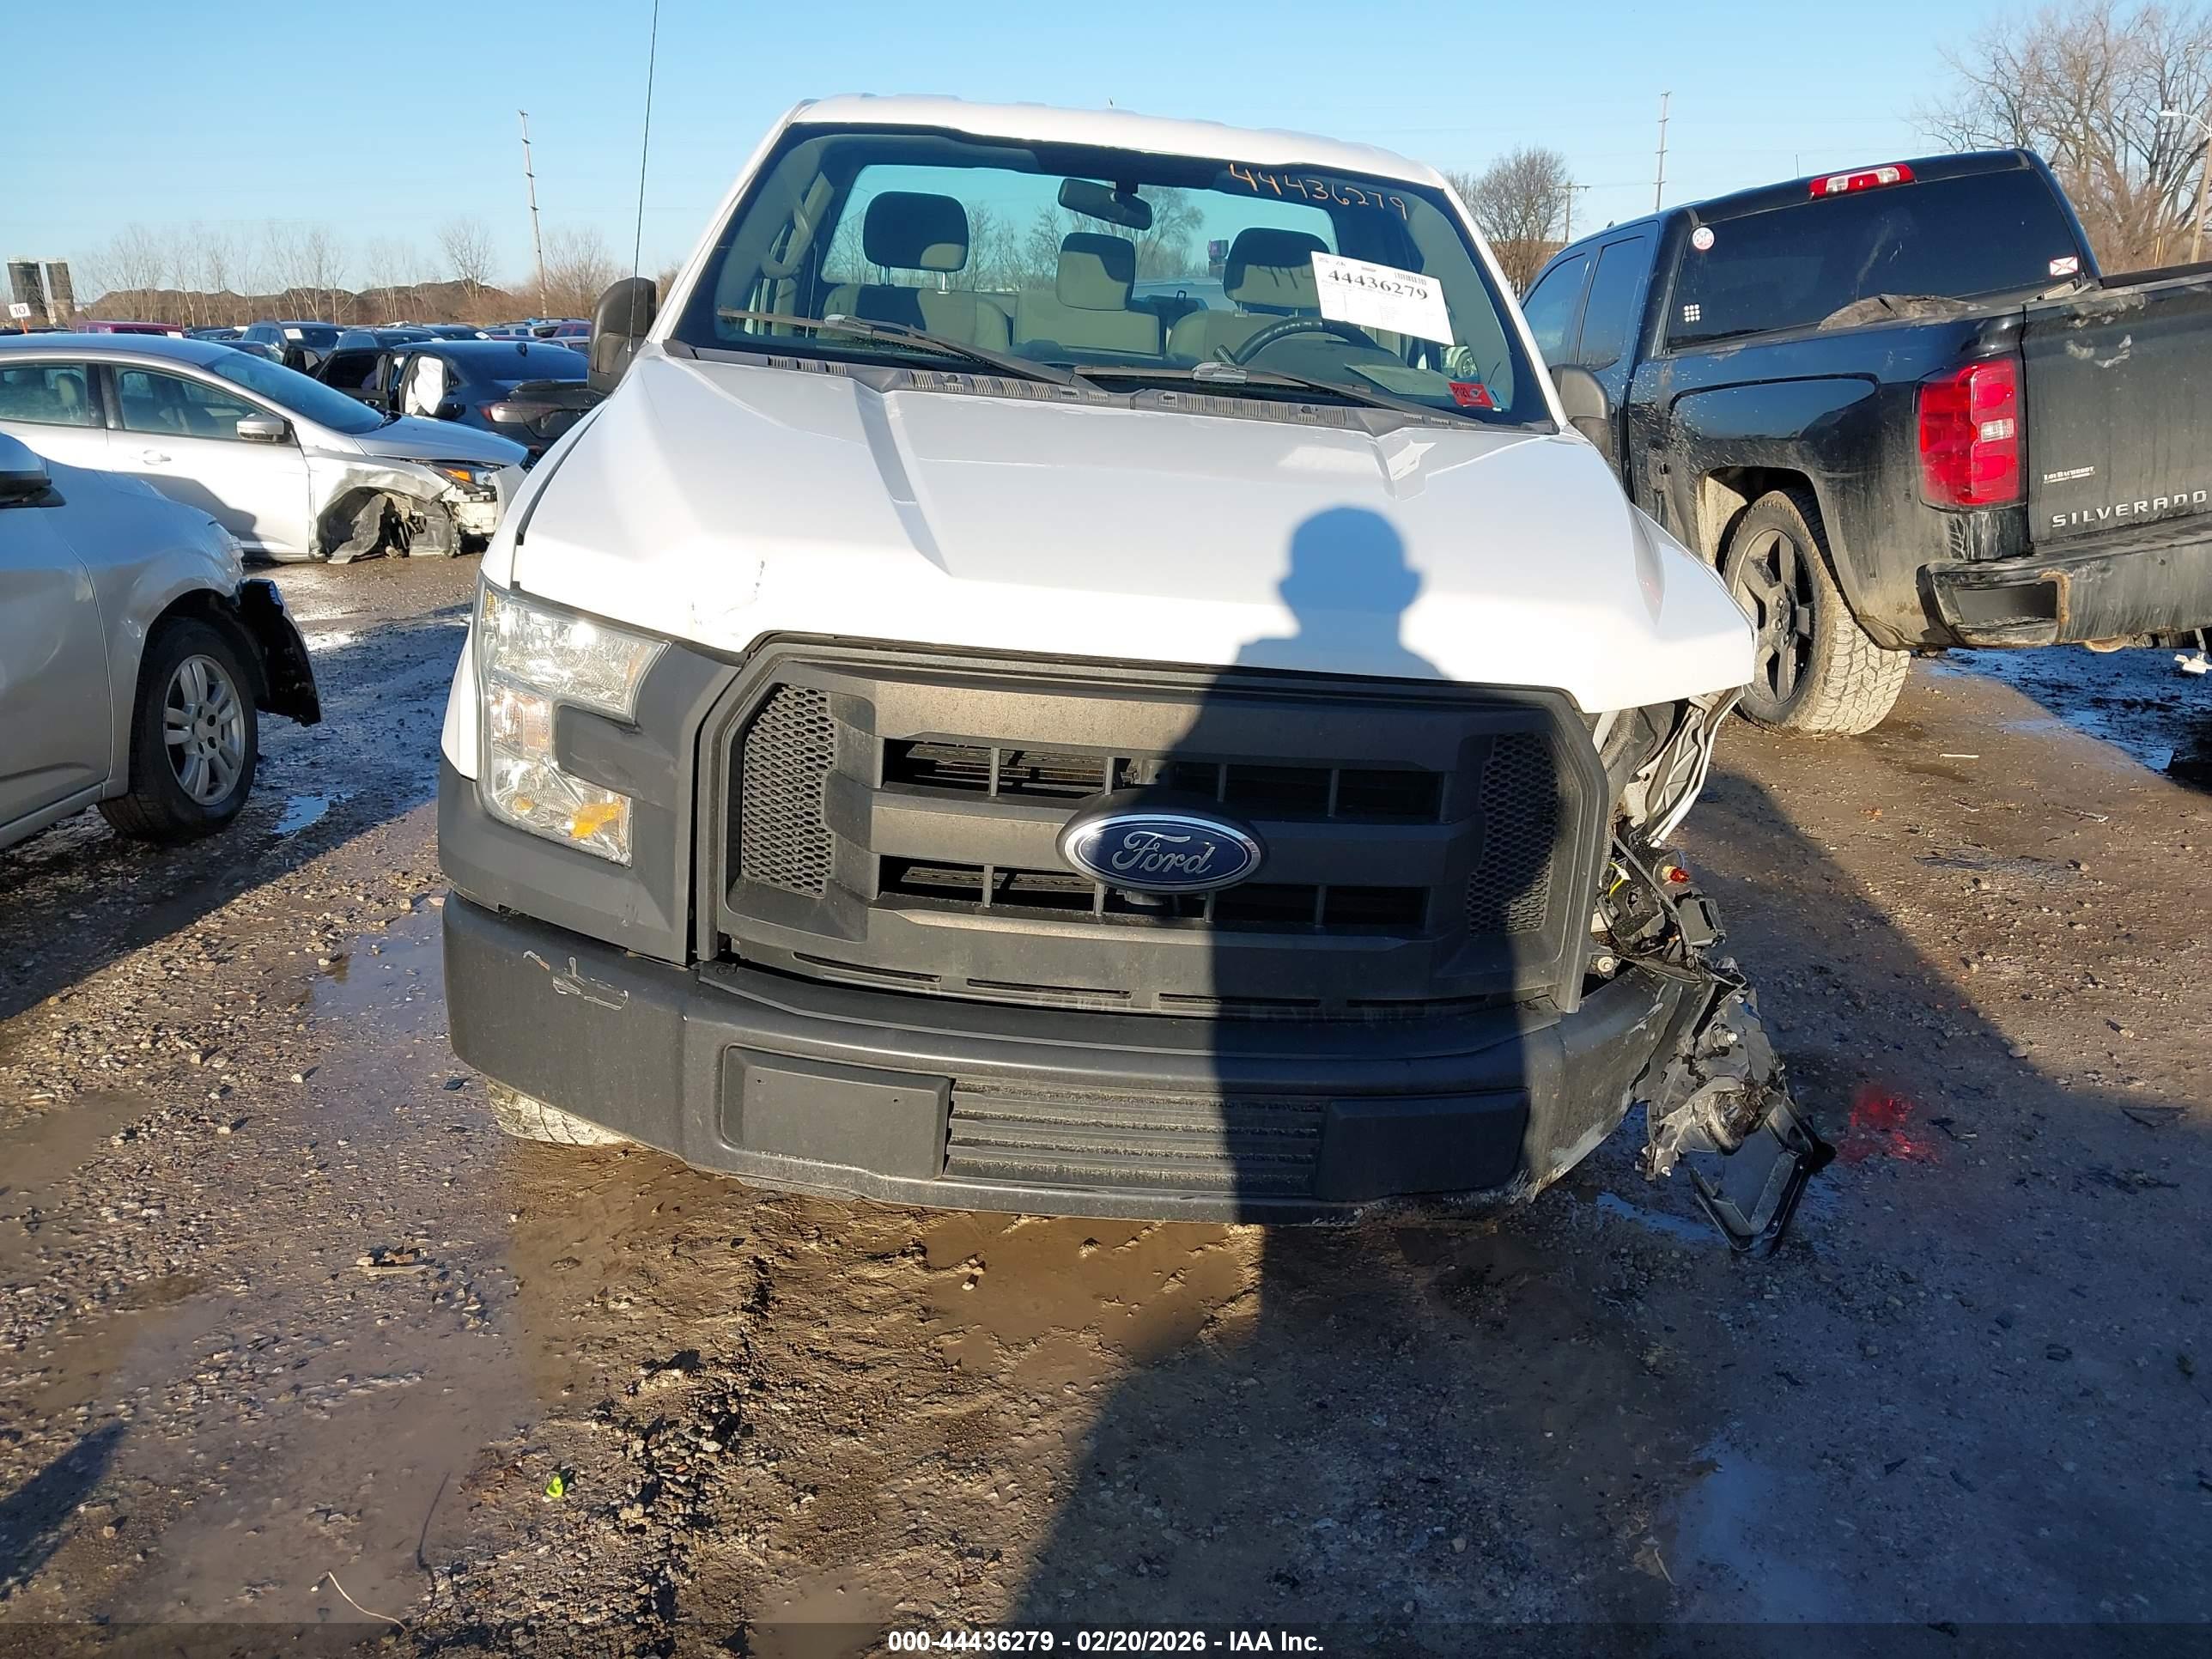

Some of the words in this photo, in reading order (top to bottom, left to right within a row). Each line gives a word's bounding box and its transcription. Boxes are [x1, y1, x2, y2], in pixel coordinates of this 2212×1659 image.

[1229, 162, 1408, 221] 44436279
[1328, 270, 1429, 301] 44436279
[14, 306, 26, 315] 10
[2051, 489, 2208, 528] SILVERADO
[1110, 830, 1216, 874] Ford
